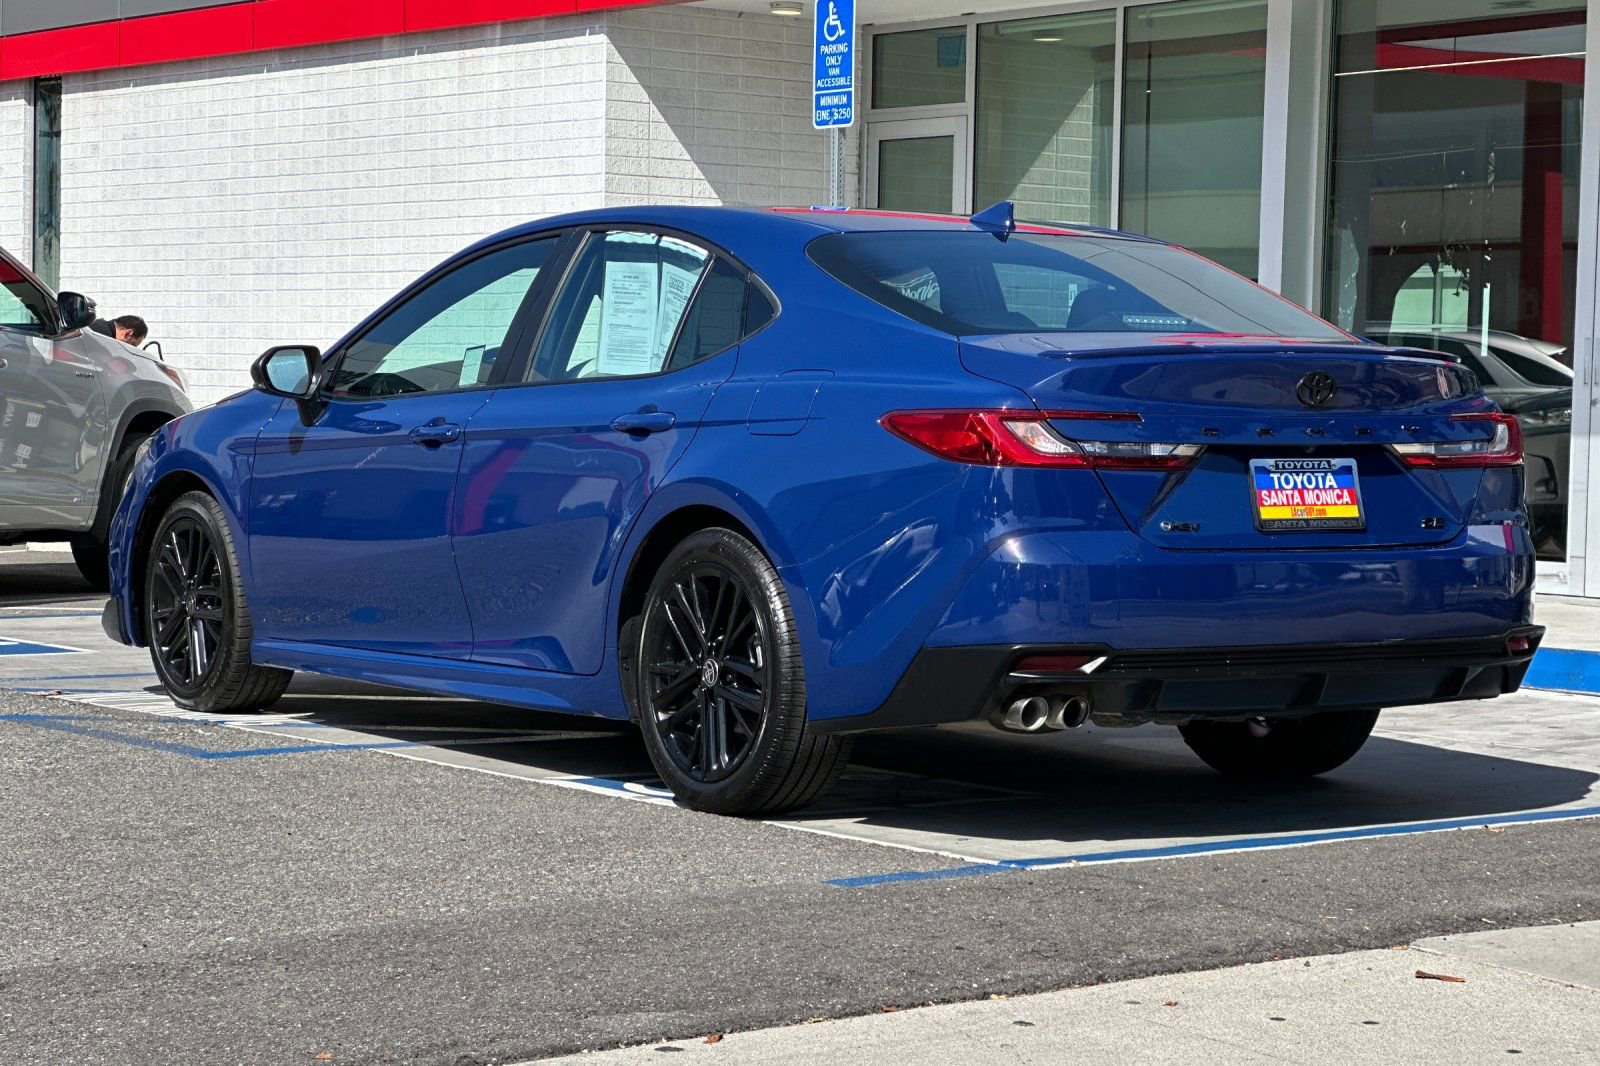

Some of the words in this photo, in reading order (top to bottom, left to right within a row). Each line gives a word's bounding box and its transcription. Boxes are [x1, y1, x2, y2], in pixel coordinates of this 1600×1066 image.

[820, 43, 848, 55] PARKING
[825, 55, 842, 66] ONLY
[828, 67, 840, 76] VAN
[817, 76, 851, 88] ACCESSIBLE
[820, 94, 847, 106] MINIMUM
[833, 107, 851, 120] $250
[1276, 461, 1329, 469] TOYOTA
[1269, 472, 1338, 489] TOYOTA
[1261, 490, 1302, 506] SANTA
[1304, 489, 1352, 505] MONICA
[1265, 520, 1306, 529] SANTA
[1308, 519, 1358, 528] MONICA
